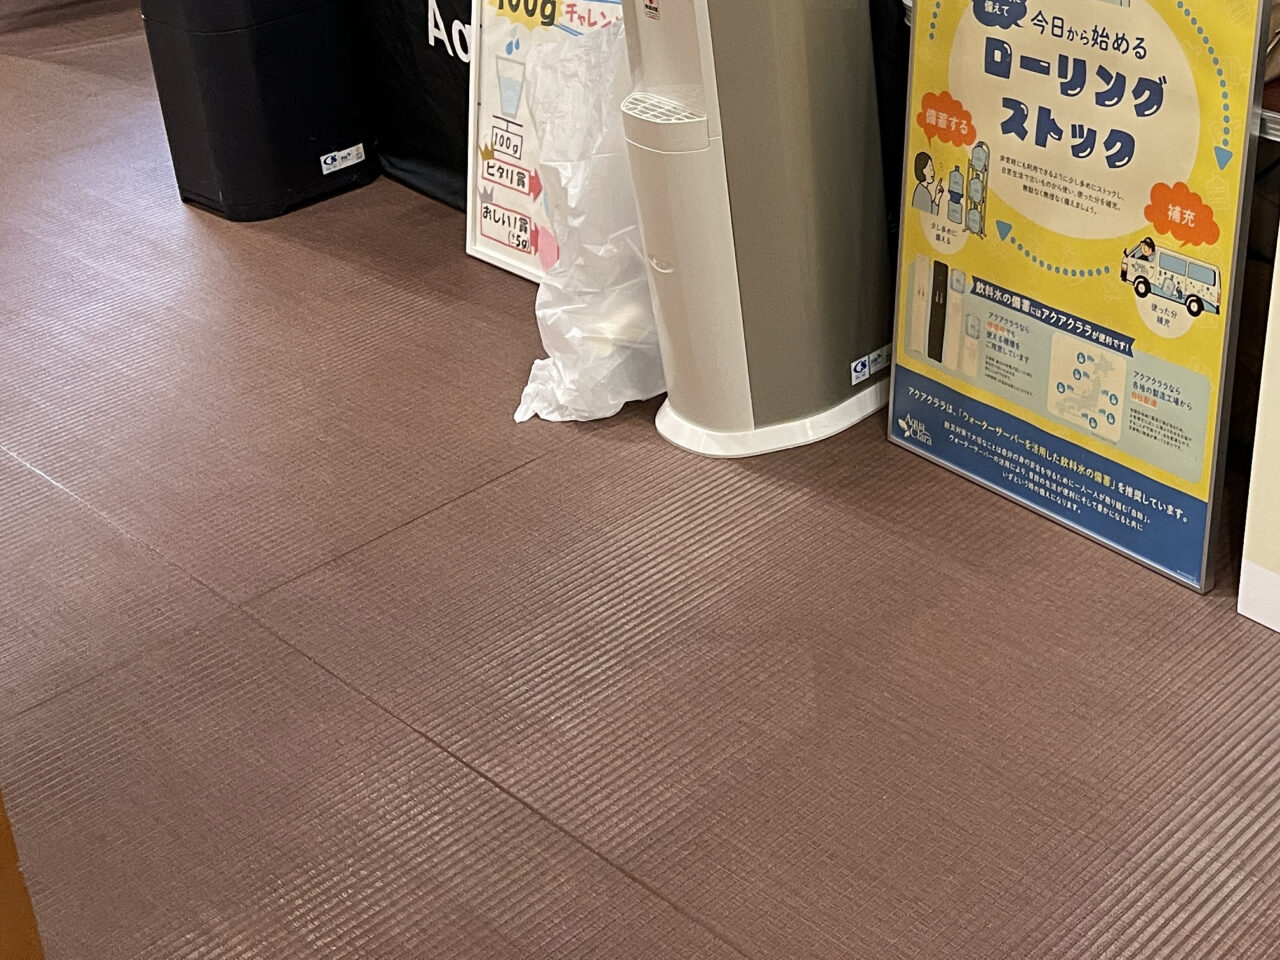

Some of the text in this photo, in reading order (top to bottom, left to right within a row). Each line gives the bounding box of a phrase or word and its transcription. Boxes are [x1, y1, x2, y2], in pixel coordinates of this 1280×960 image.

[984, 0, 1009, 18] 備えて
[1030, 10, 1148, 60] 今日から始める
[984, 36, 1168, 118] ローリング
[494, 132, 519, 155] 100g
[1000, 96, 1136, 169] ストック
[1167, 203, 1196, 227] 補充
[1151, 303, 1178, 319] 使った分
[1133, 371, 1181, 395] アクアクララなら
